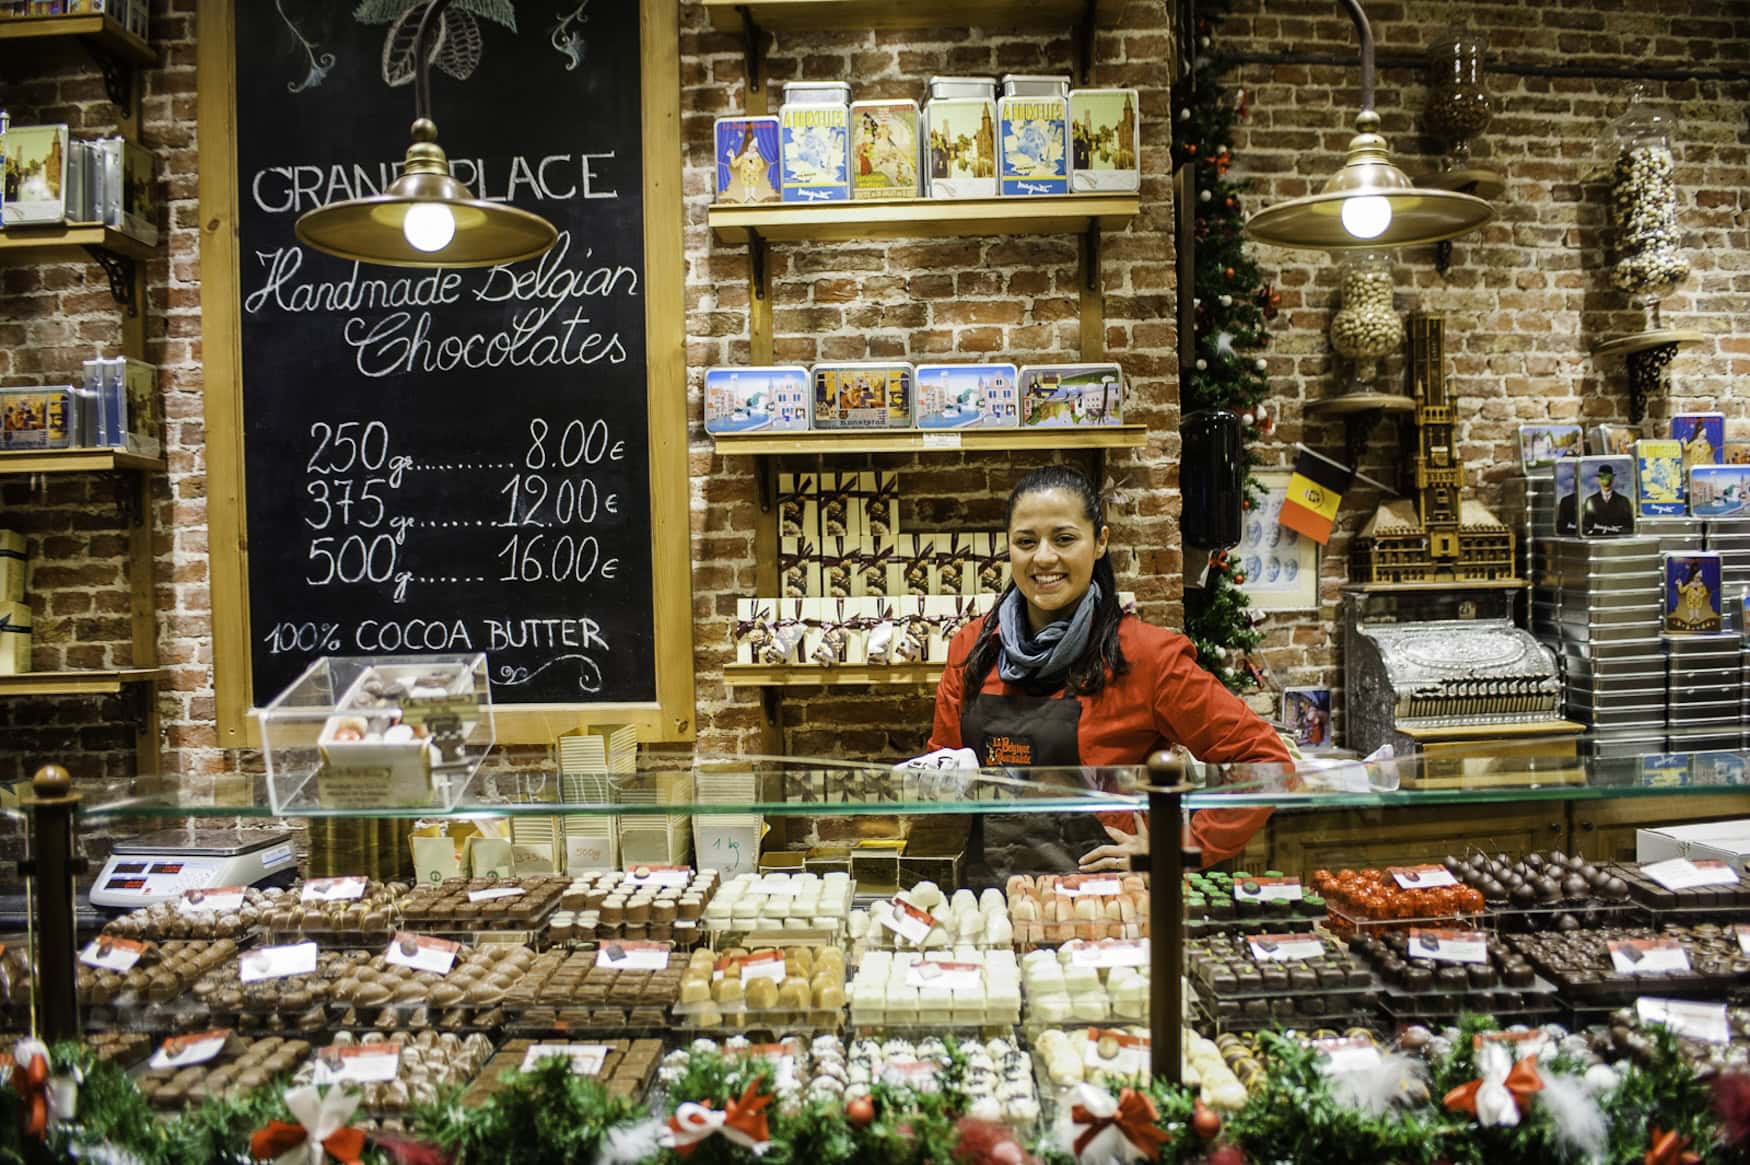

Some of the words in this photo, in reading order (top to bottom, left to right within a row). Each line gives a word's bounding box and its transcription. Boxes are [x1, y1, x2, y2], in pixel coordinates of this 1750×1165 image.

[448, 151, 618, 201] PLACE
[245, 247, 462, 313] Handmade
[344, 306, 627, 378] Chocolates
[264, 621, 341, 654] 100%
[356, 620, 472, 650] COCOA
[483, 618, 609, 651] BUTTER
